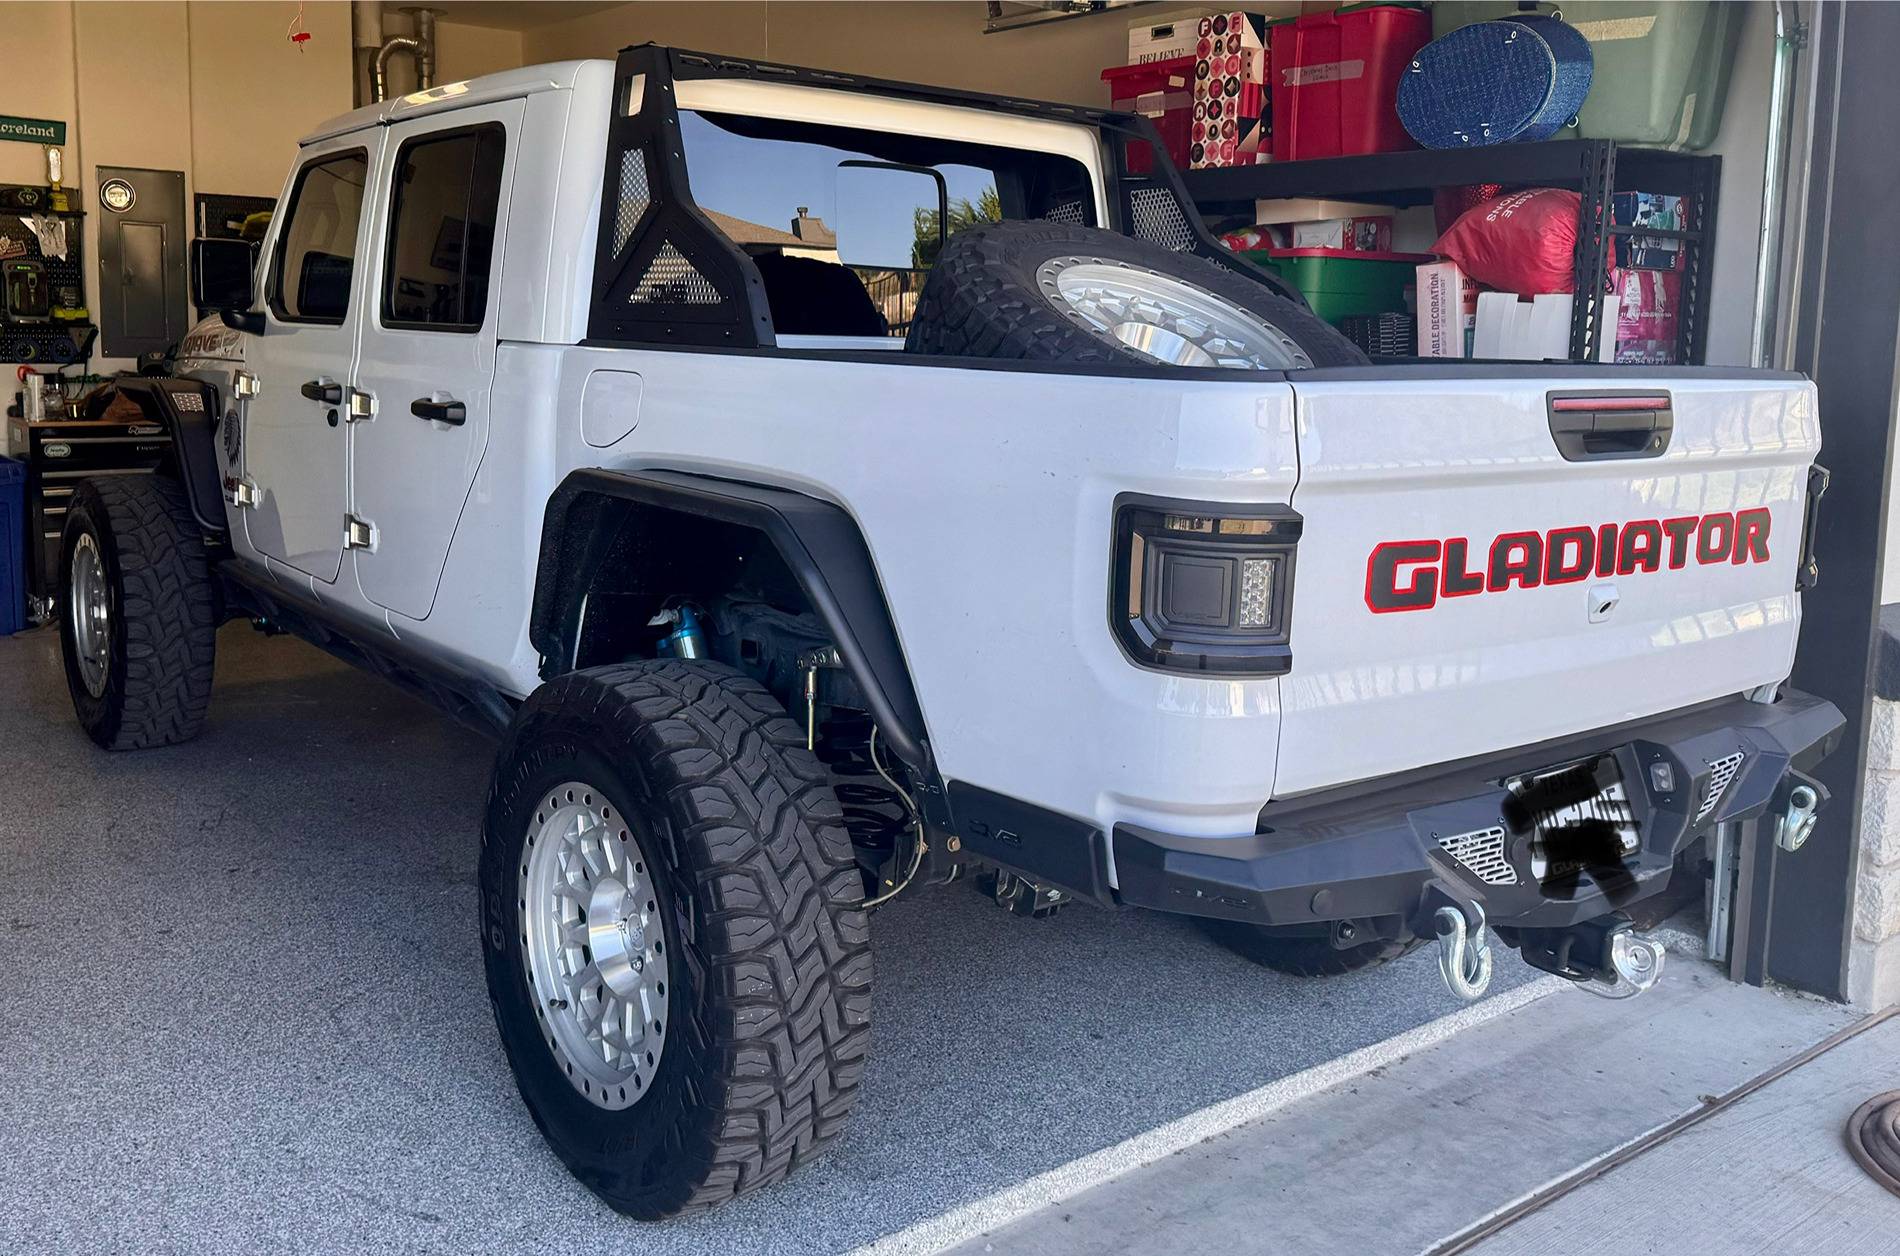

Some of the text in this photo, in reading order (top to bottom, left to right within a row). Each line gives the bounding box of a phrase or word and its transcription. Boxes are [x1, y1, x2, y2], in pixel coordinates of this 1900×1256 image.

[1139, 47, 1185, 65] BELIEVE
[0, 123, 56, 138] oreland
[1430, 272, 1440, 330] DECORATION
[182, 335, 219, 353] OJAVE
[1363, 507, 1772, 614] GLADIATOR
